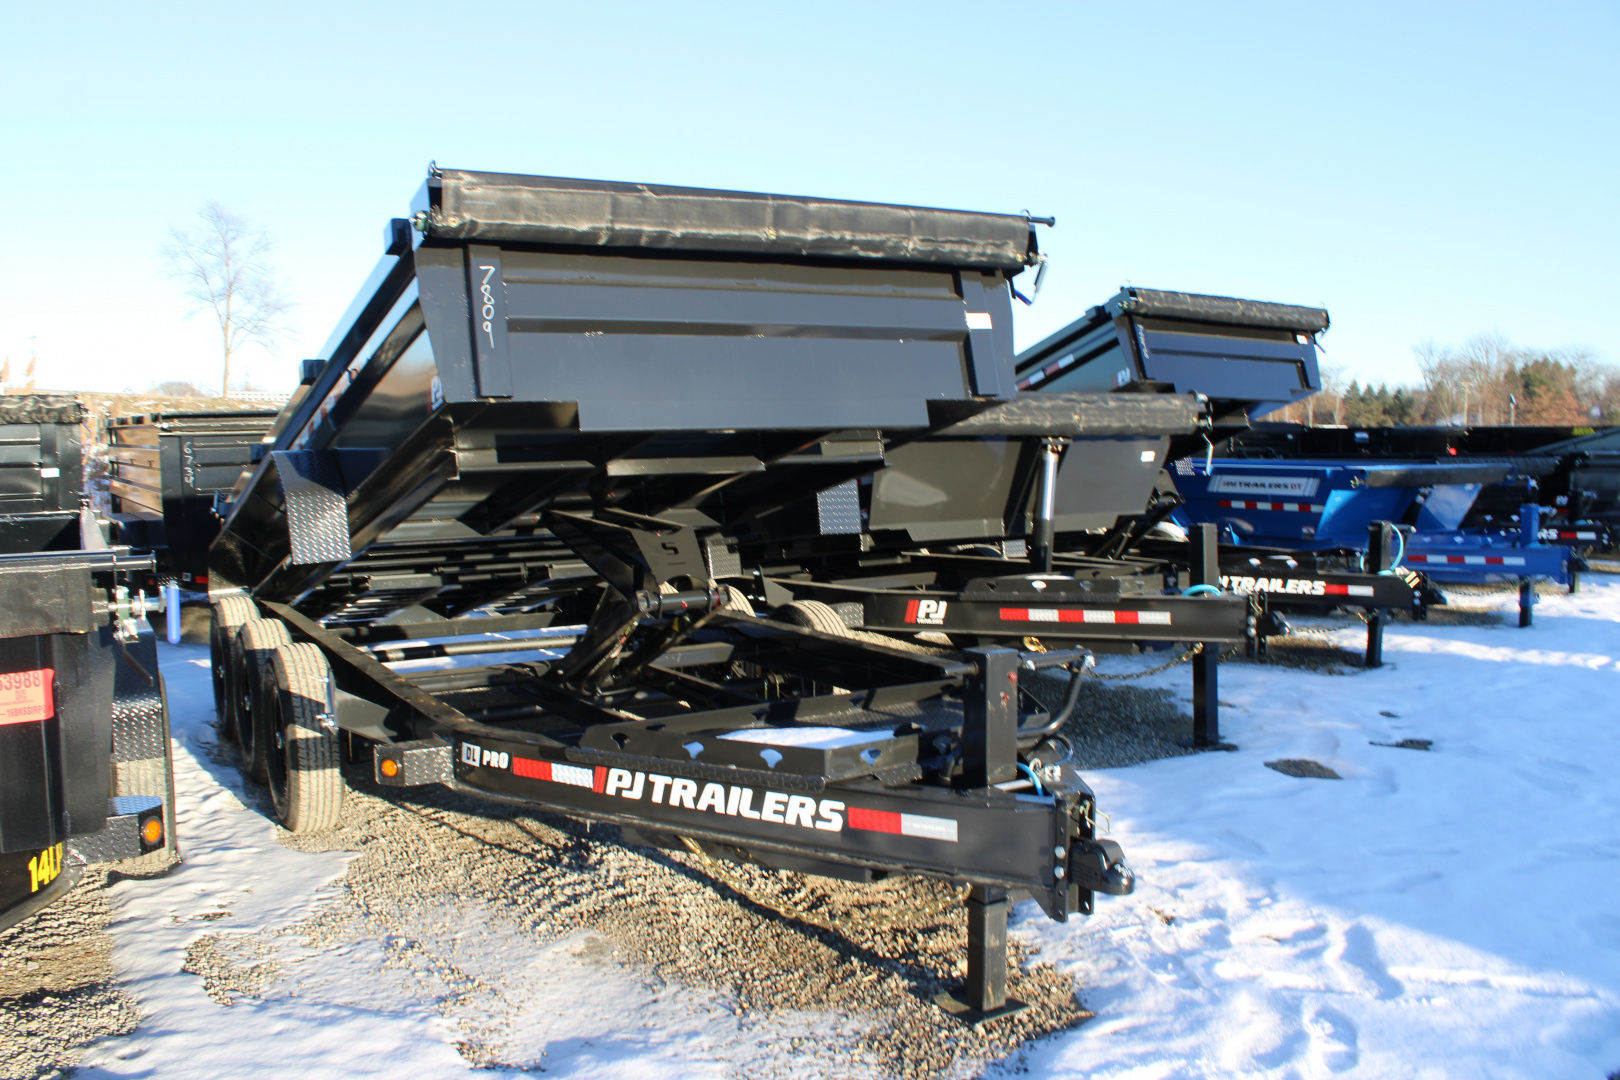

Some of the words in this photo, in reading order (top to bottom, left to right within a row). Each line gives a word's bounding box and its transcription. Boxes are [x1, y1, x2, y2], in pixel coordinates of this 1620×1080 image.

[479, 265, 496, 350] 7809
[1229, 575, 1327, 596] TRAILERS
[917, 599, 948, 619] PJ
[482, 749, 510, 770] PRO
[605, 767, 646, 800] PJ
[648, 773, 846, 833] TRAILERS
